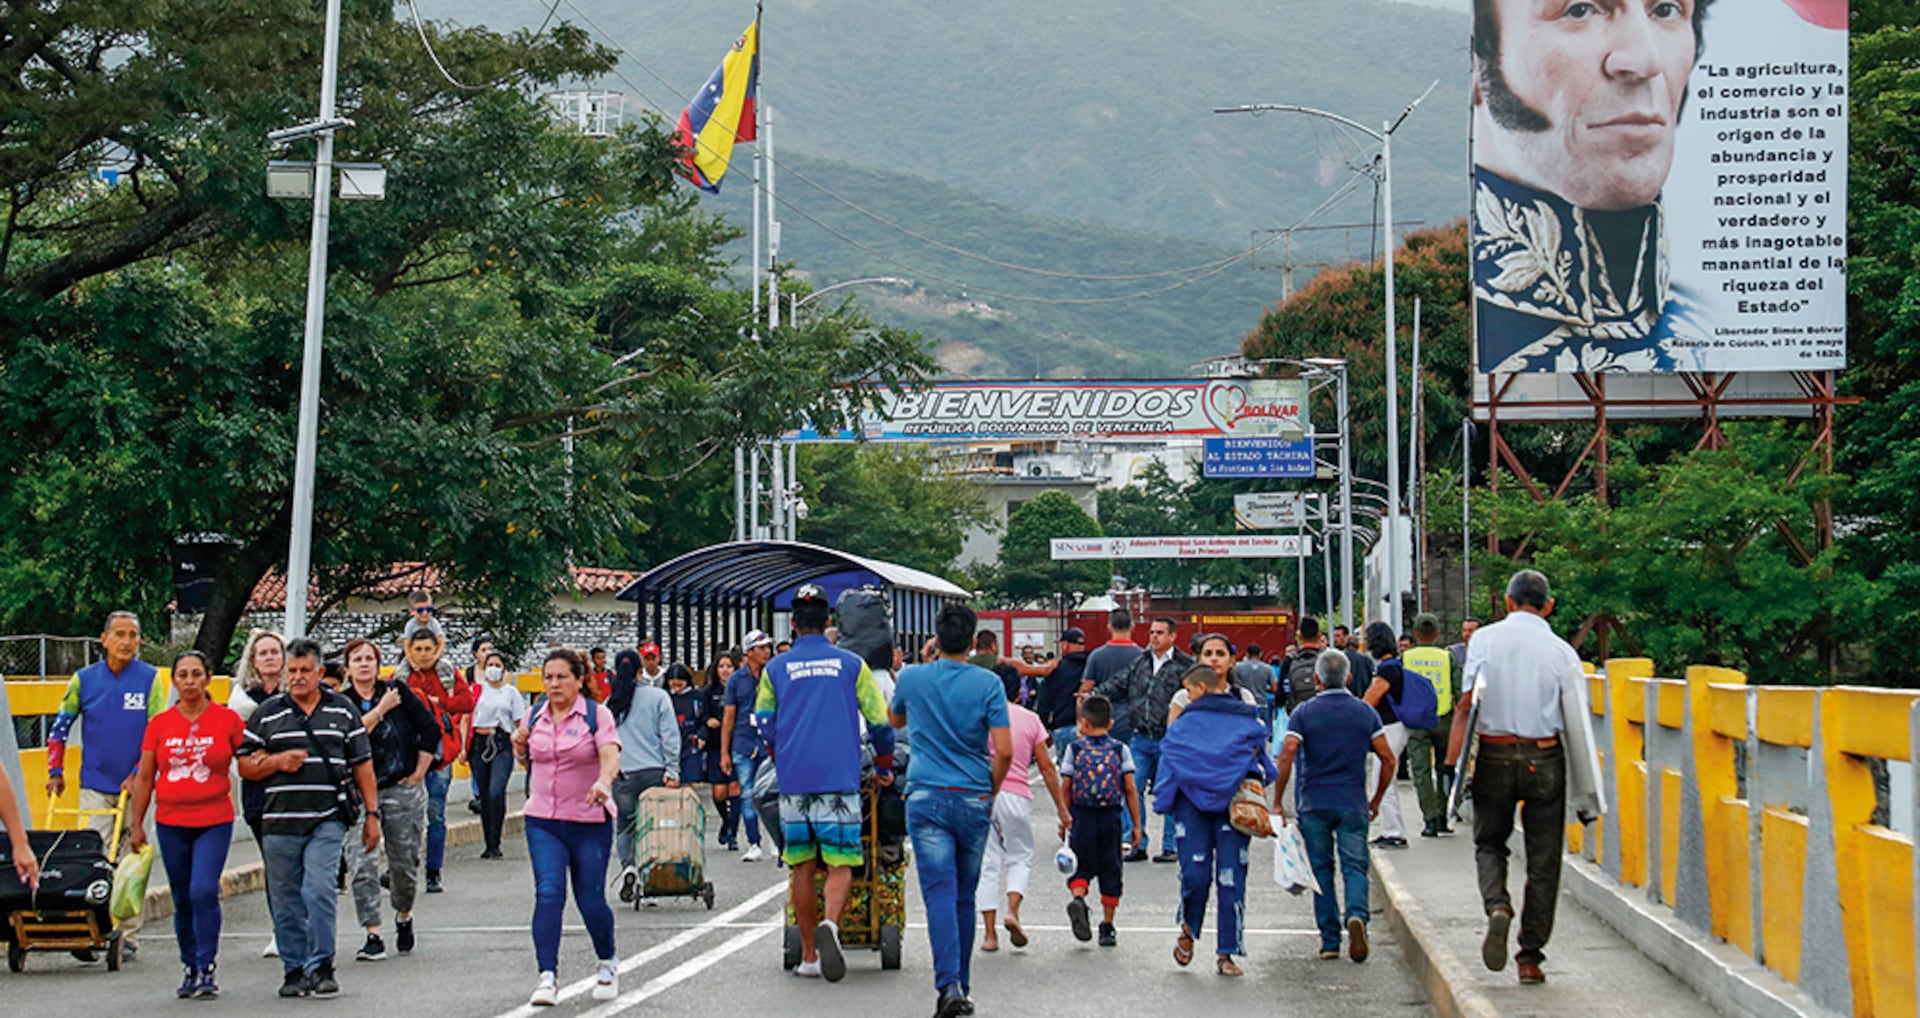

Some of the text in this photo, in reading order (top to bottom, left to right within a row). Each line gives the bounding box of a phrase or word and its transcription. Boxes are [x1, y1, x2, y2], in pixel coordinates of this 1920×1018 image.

[1699, 62, 1843, 79] "La agricultura,
[1697, 83, 1844, 100] el comercio y la
[1700, 104, 1842, 120] industria son el
[1717, 126, 1826, 144] origen de la
[1710, 148, 1833, 164] abundancia y
[1717, 169, 1826, 187] prosperidad
[1714, 191, 1830, 208] nacional y el
[1717, 214, 1827, 229] verdadero y
[1702, 234, 1843, 251] más inagotable
[1702, 255, 1844, 271] manantial de la
[1722, 278, 1823, 294] riqueza del
[1738, 300, 1809, 313] Estado"
[1714, 327, 1769, 335] Libertador
[1713, 339, 1725, 347] de
[1772, 338, 1782, 346] el
[1799, 337, 1812, 346] de
[1816, 337, 1844, 348] mayo
[1799, 350, 1812, 358] de
[893, 390, 1198, 419] BIENVENIDOS
[904, 420, 1174, 434] REPÚBLICA BOLIVARIANA DE VENEZUELA
[1207, 451, 1221, 461] AL
[1223, 451, 1263, 461] ESTADO
[1159, 538, 1191, 548] Principal
[1193, 538, 1206, 546] San
[1198, 547, 1230, 555] Primaria
